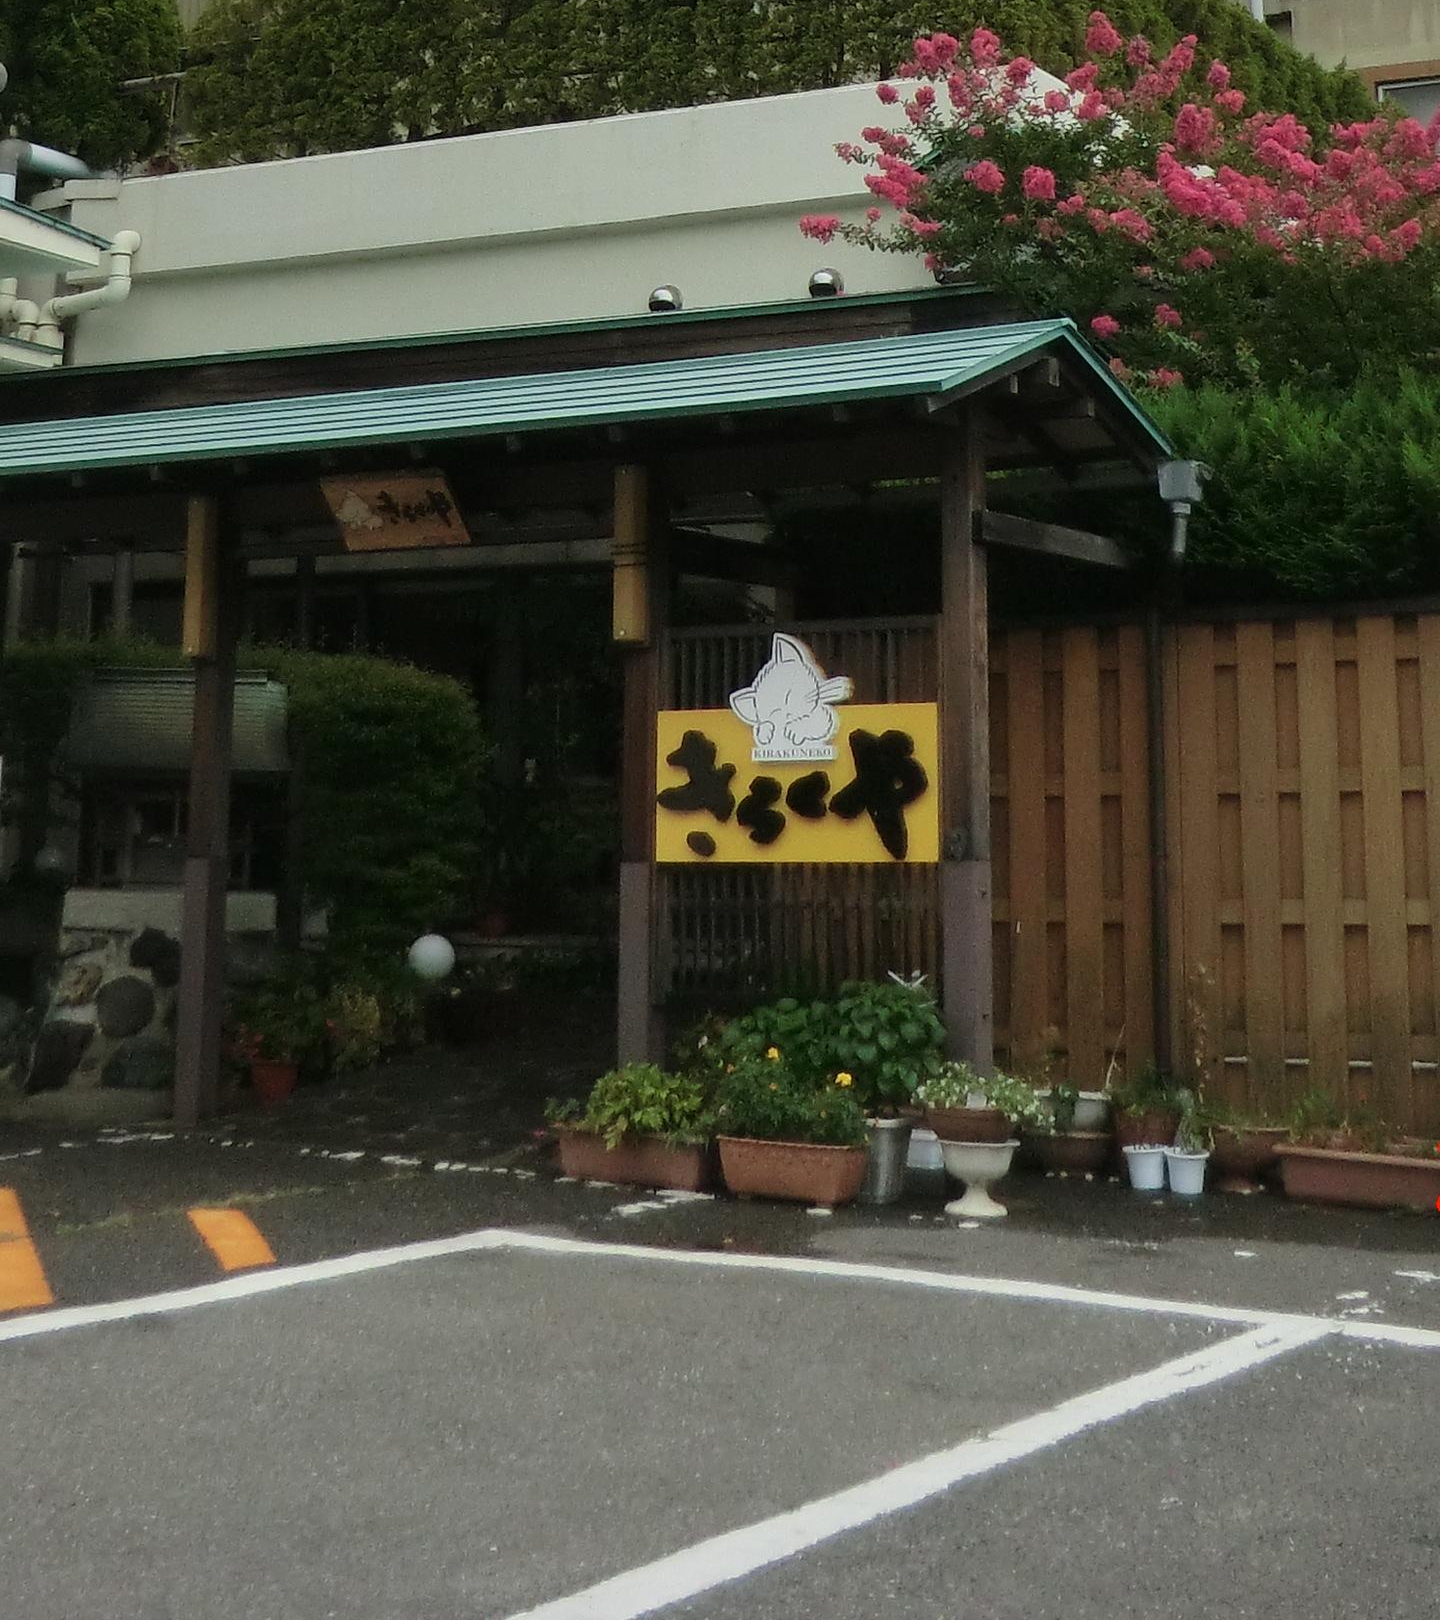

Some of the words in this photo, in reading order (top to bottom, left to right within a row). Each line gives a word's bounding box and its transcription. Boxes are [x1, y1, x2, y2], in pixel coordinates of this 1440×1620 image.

[754, 748, 831, 759] KIRAKUNEKO
[657, 729, 927, 860] きらくや
